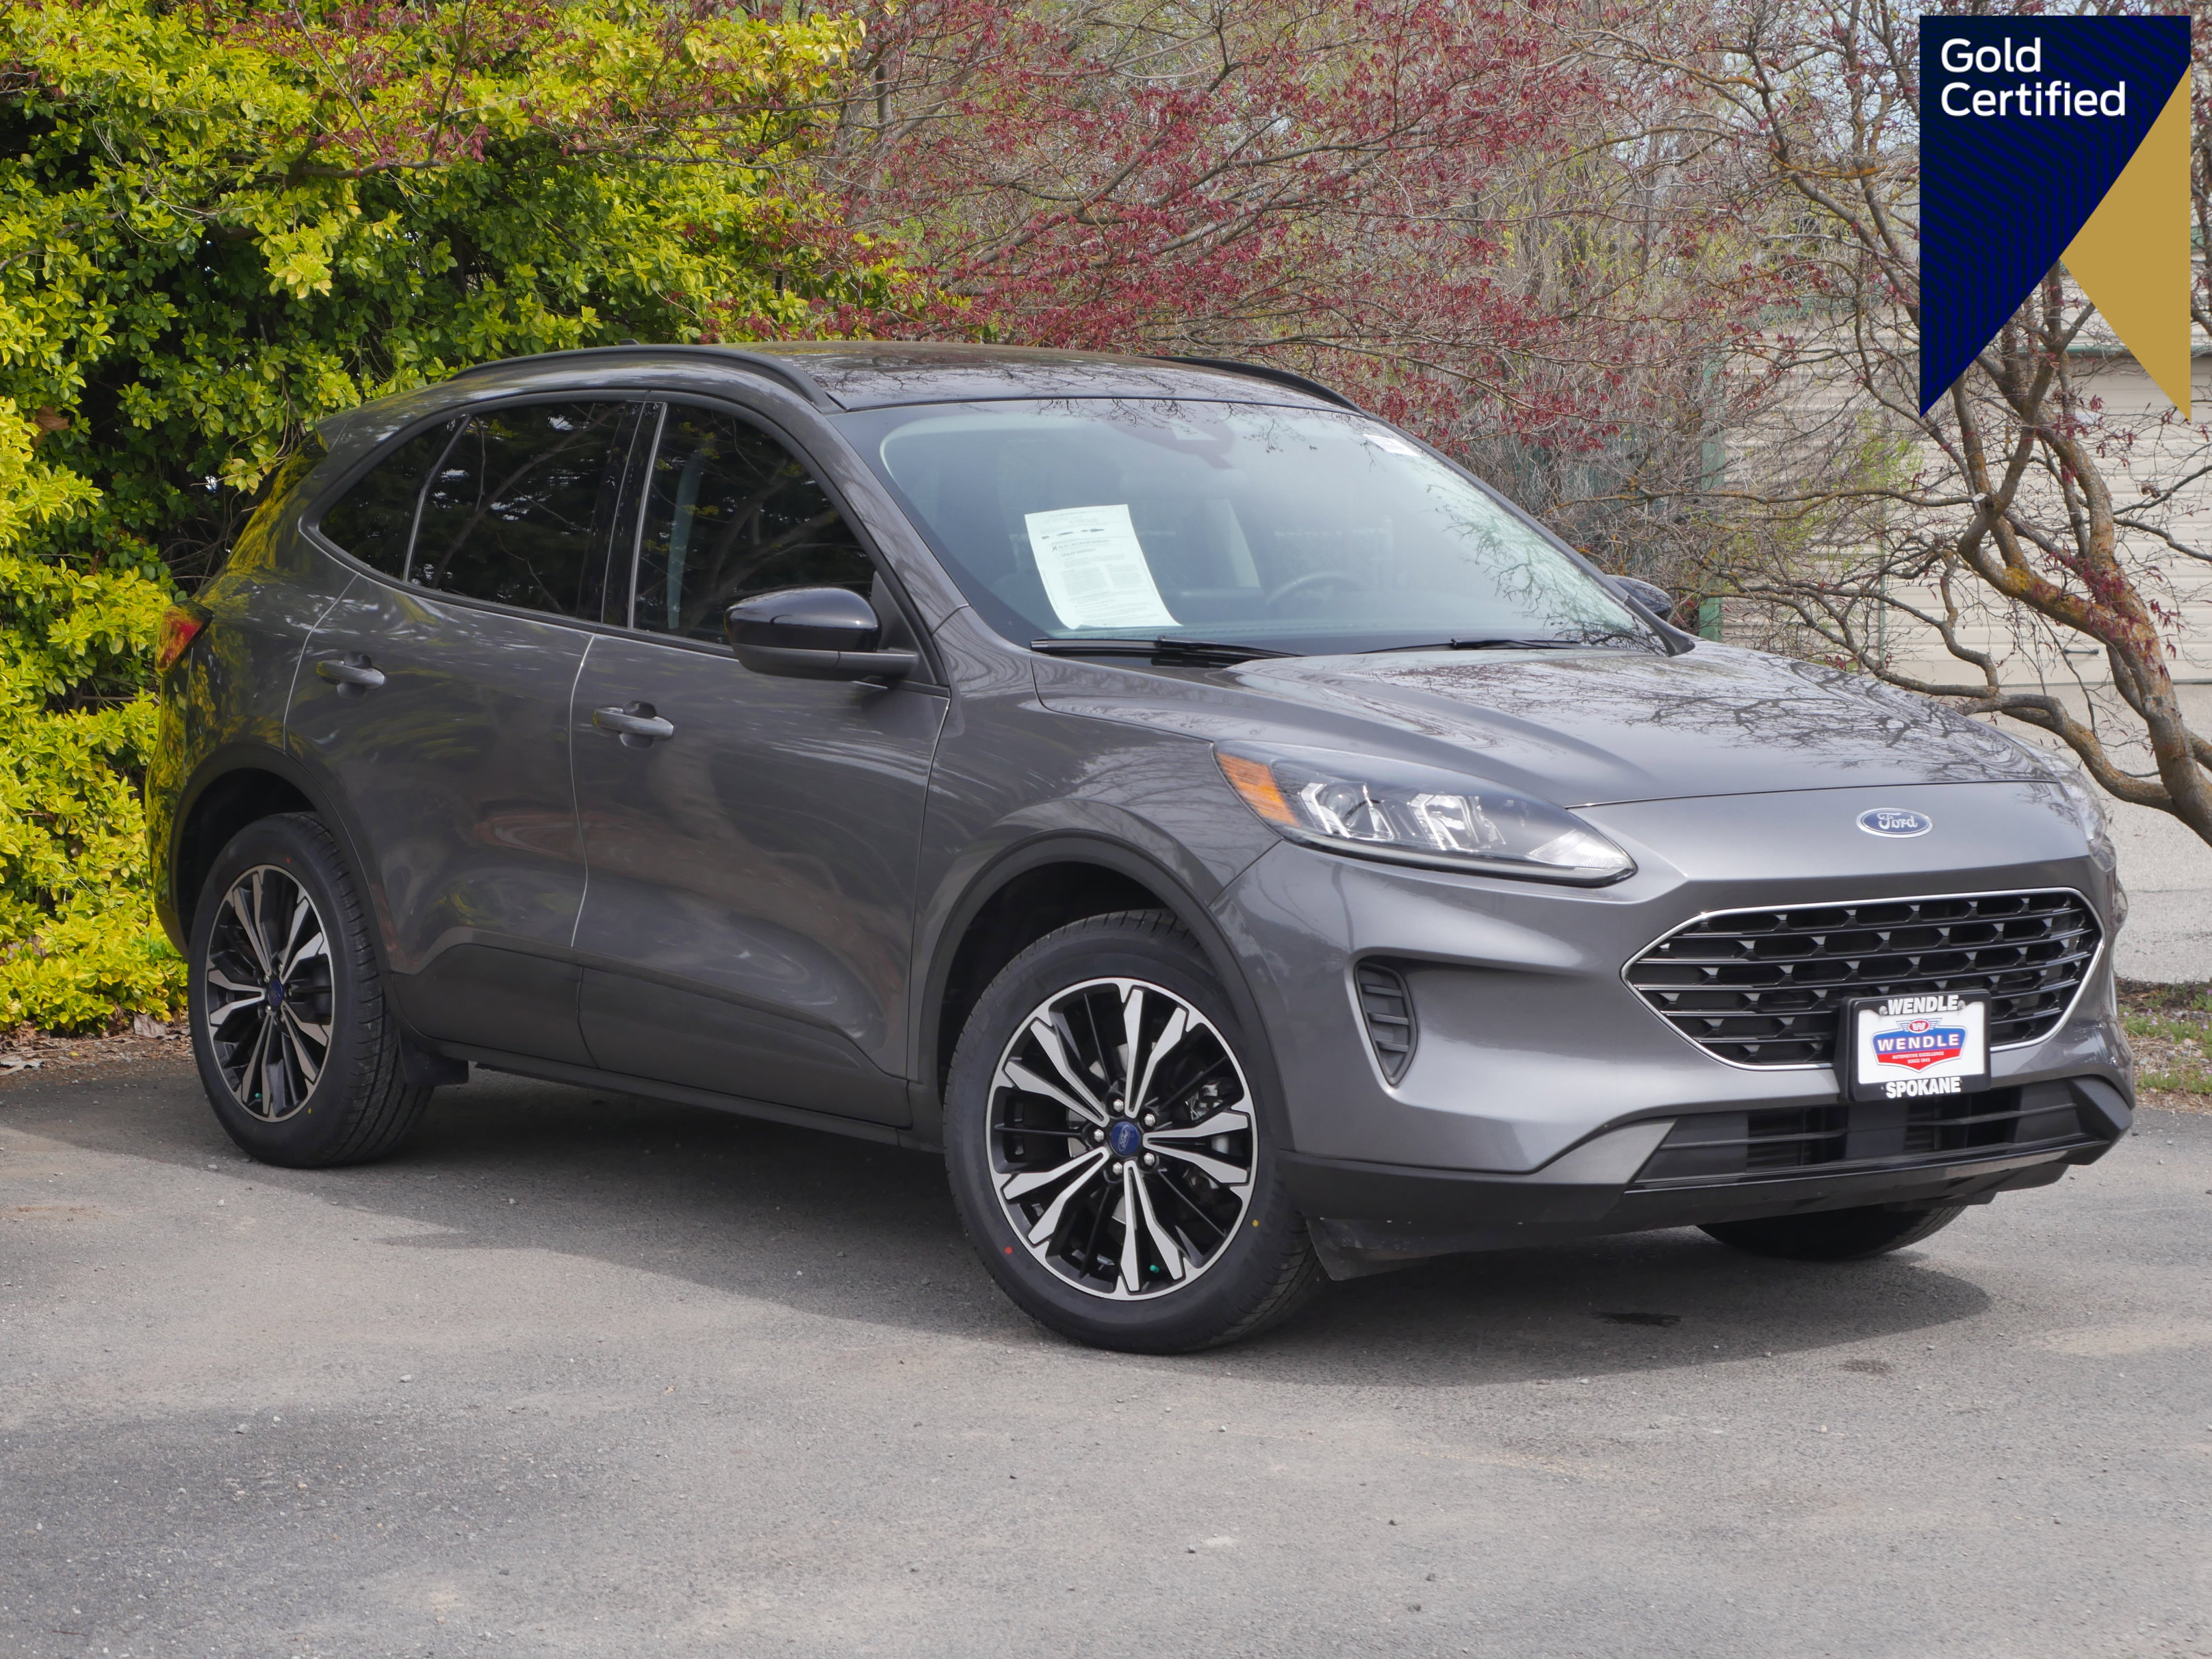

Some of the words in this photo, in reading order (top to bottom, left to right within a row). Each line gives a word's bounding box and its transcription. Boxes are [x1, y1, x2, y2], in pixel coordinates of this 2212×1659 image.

[1877, 812, 1918, 830] Ford
[1888, 994, 1959, 1015] WENDLE
[1877, 1034, 1959, 1051] WENDLE
[1886, 1076, 1961, 1098] SPOKANE
